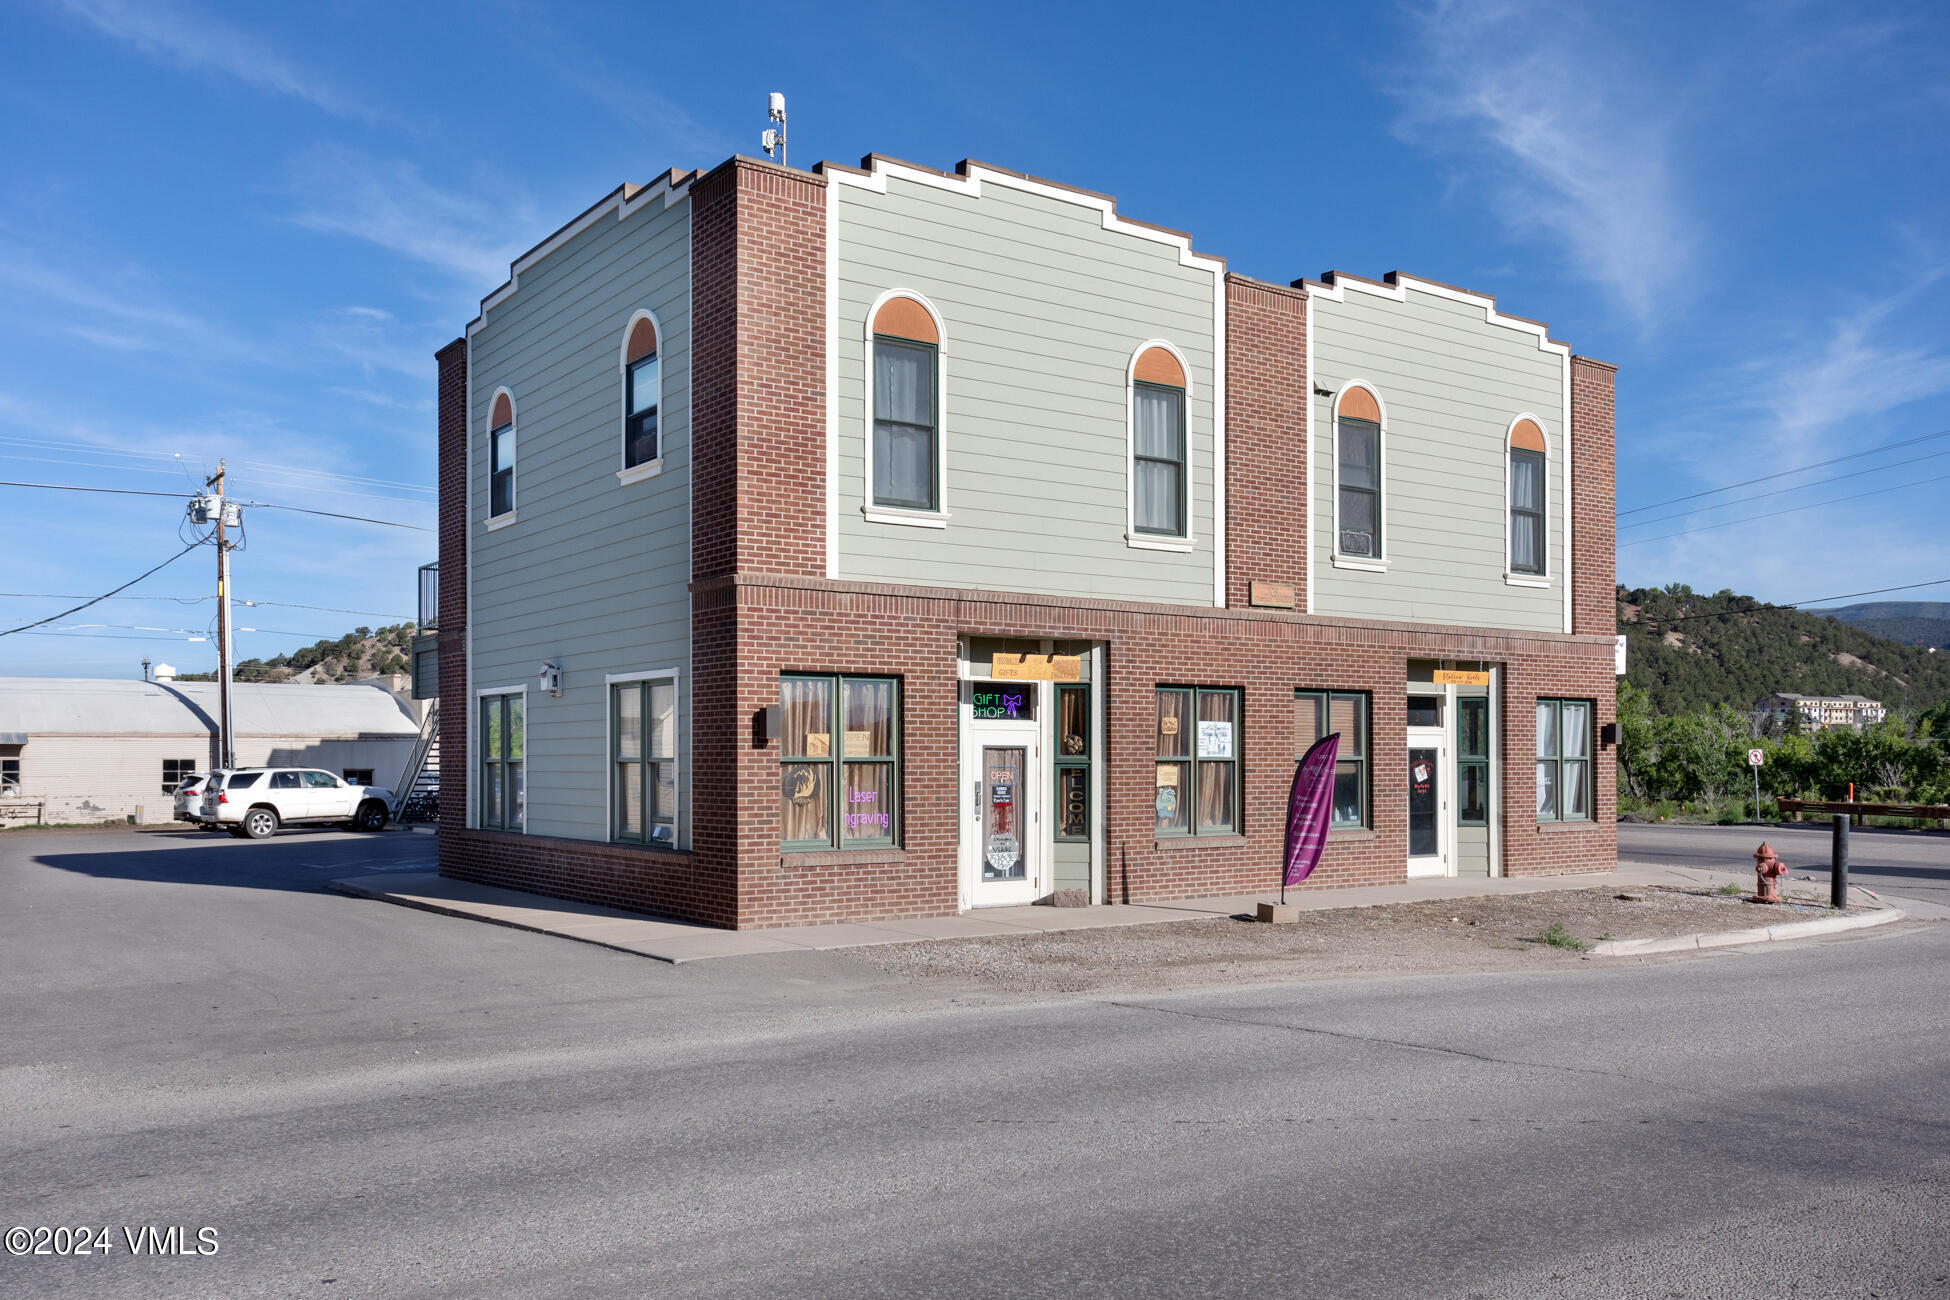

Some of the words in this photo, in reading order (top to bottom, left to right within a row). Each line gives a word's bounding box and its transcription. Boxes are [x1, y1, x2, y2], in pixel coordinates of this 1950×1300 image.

[998, 669, 1018, 677] GIFTS
[973, 693, 1000, 705] GIFT
[973, 706, 1005, 718] SHOP
[990, 771, 1014, 780] OPEN
[849, 786, 877, 803] Laser
[1068, 767, 1084, 836] ELCOME
[843, 810, 889, 828] ngraving
